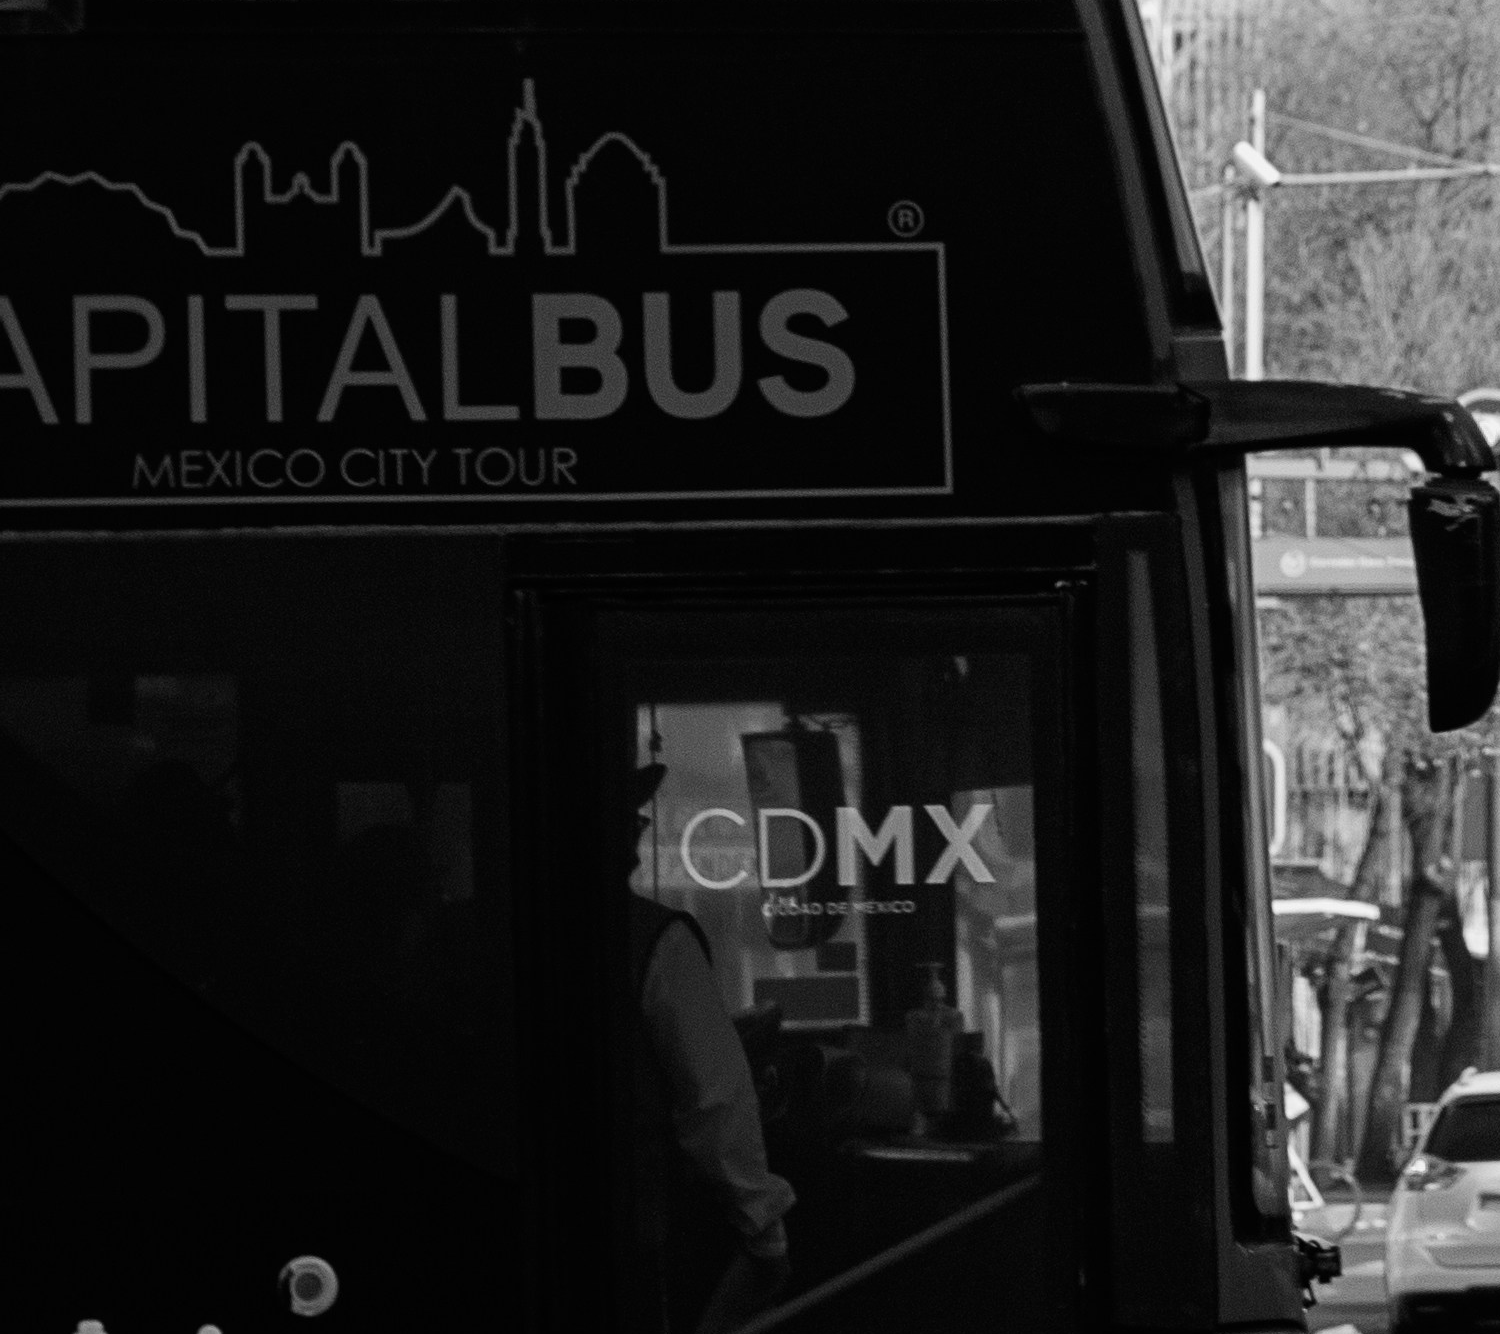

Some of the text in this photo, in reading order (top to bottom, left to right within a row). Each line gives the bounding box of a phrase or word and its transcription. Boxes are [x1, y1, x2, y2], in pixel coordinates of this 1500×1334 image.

[132, 446, 580, 491] MEXICO CITY TOUR
[680, 803, 997, 890] CDMX
